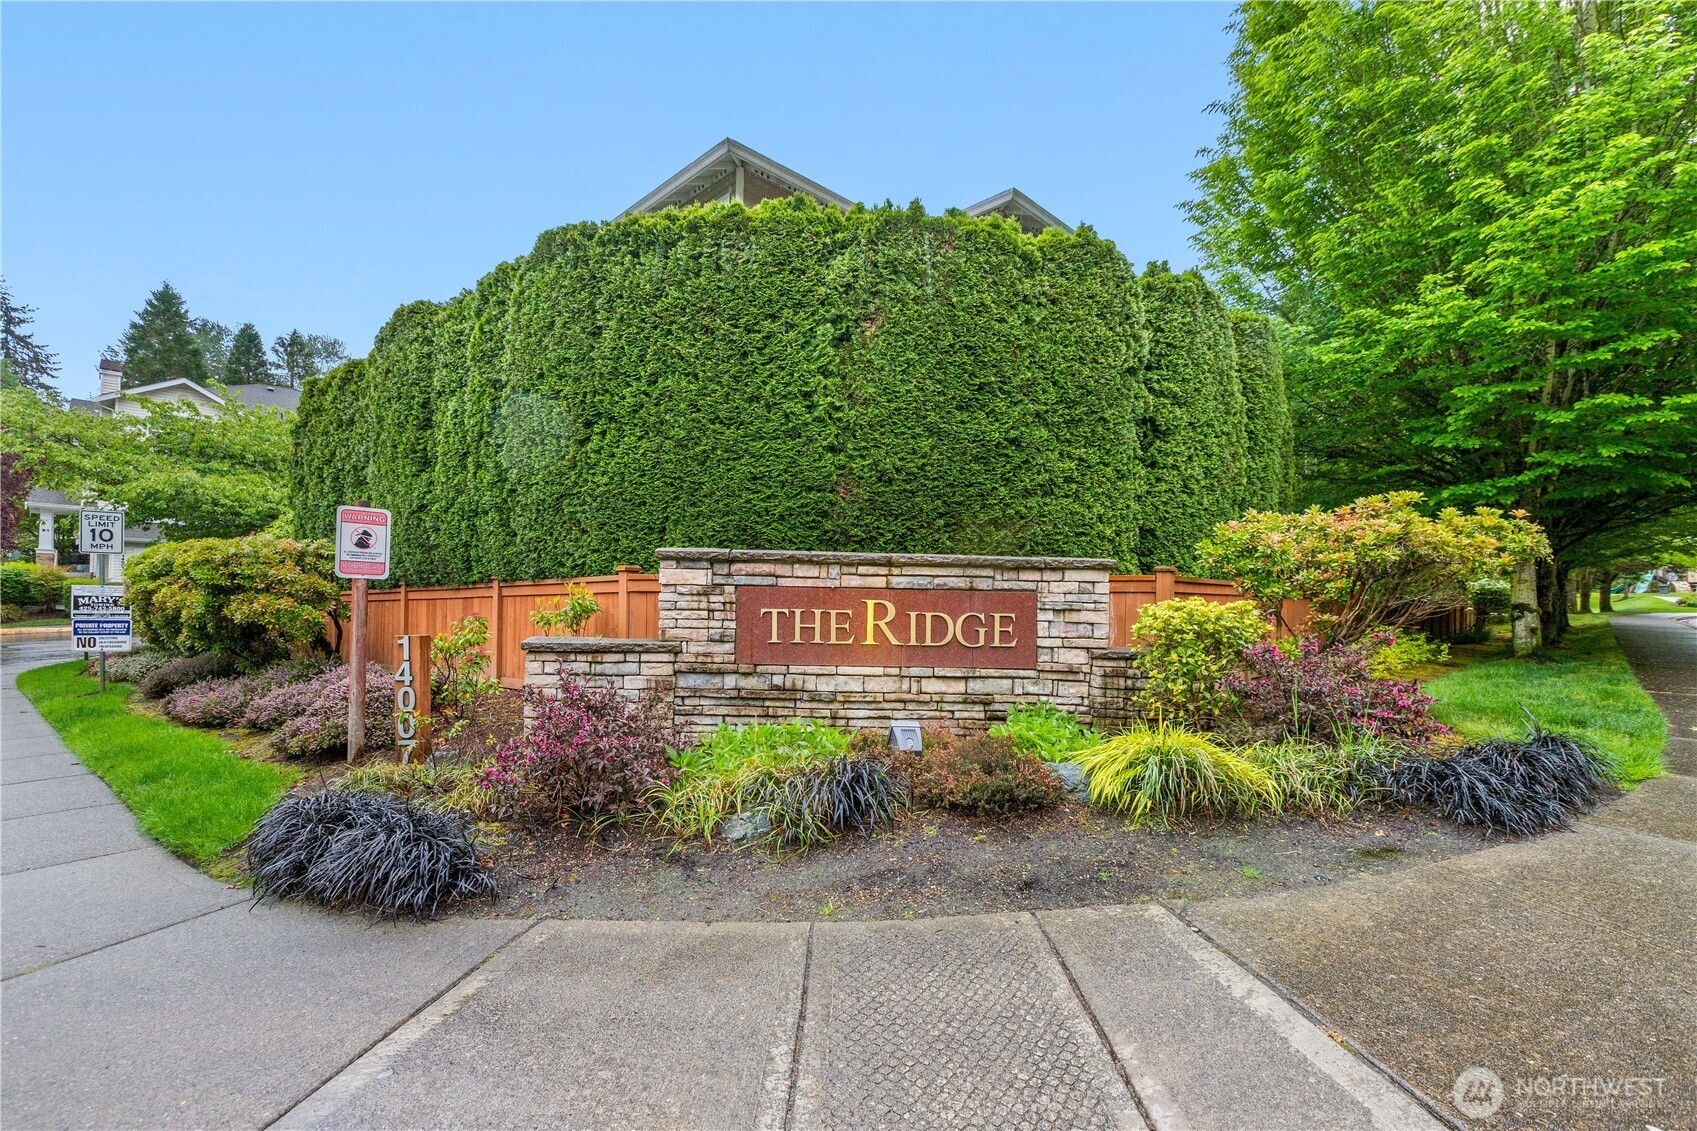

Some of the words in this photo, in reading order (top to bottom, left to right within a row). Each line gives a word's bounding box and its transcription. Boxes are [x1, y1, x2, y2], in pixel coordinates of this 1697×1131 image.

[344, 513, 385, 522] WARNING
[90, 528, 114, 542] 10
[760, 608, 856, 645] THE
[860, 599, 1018, 648] RIDGE
[76, 636, 97, 649] NO
[395, 634, 417, 766] 14007
